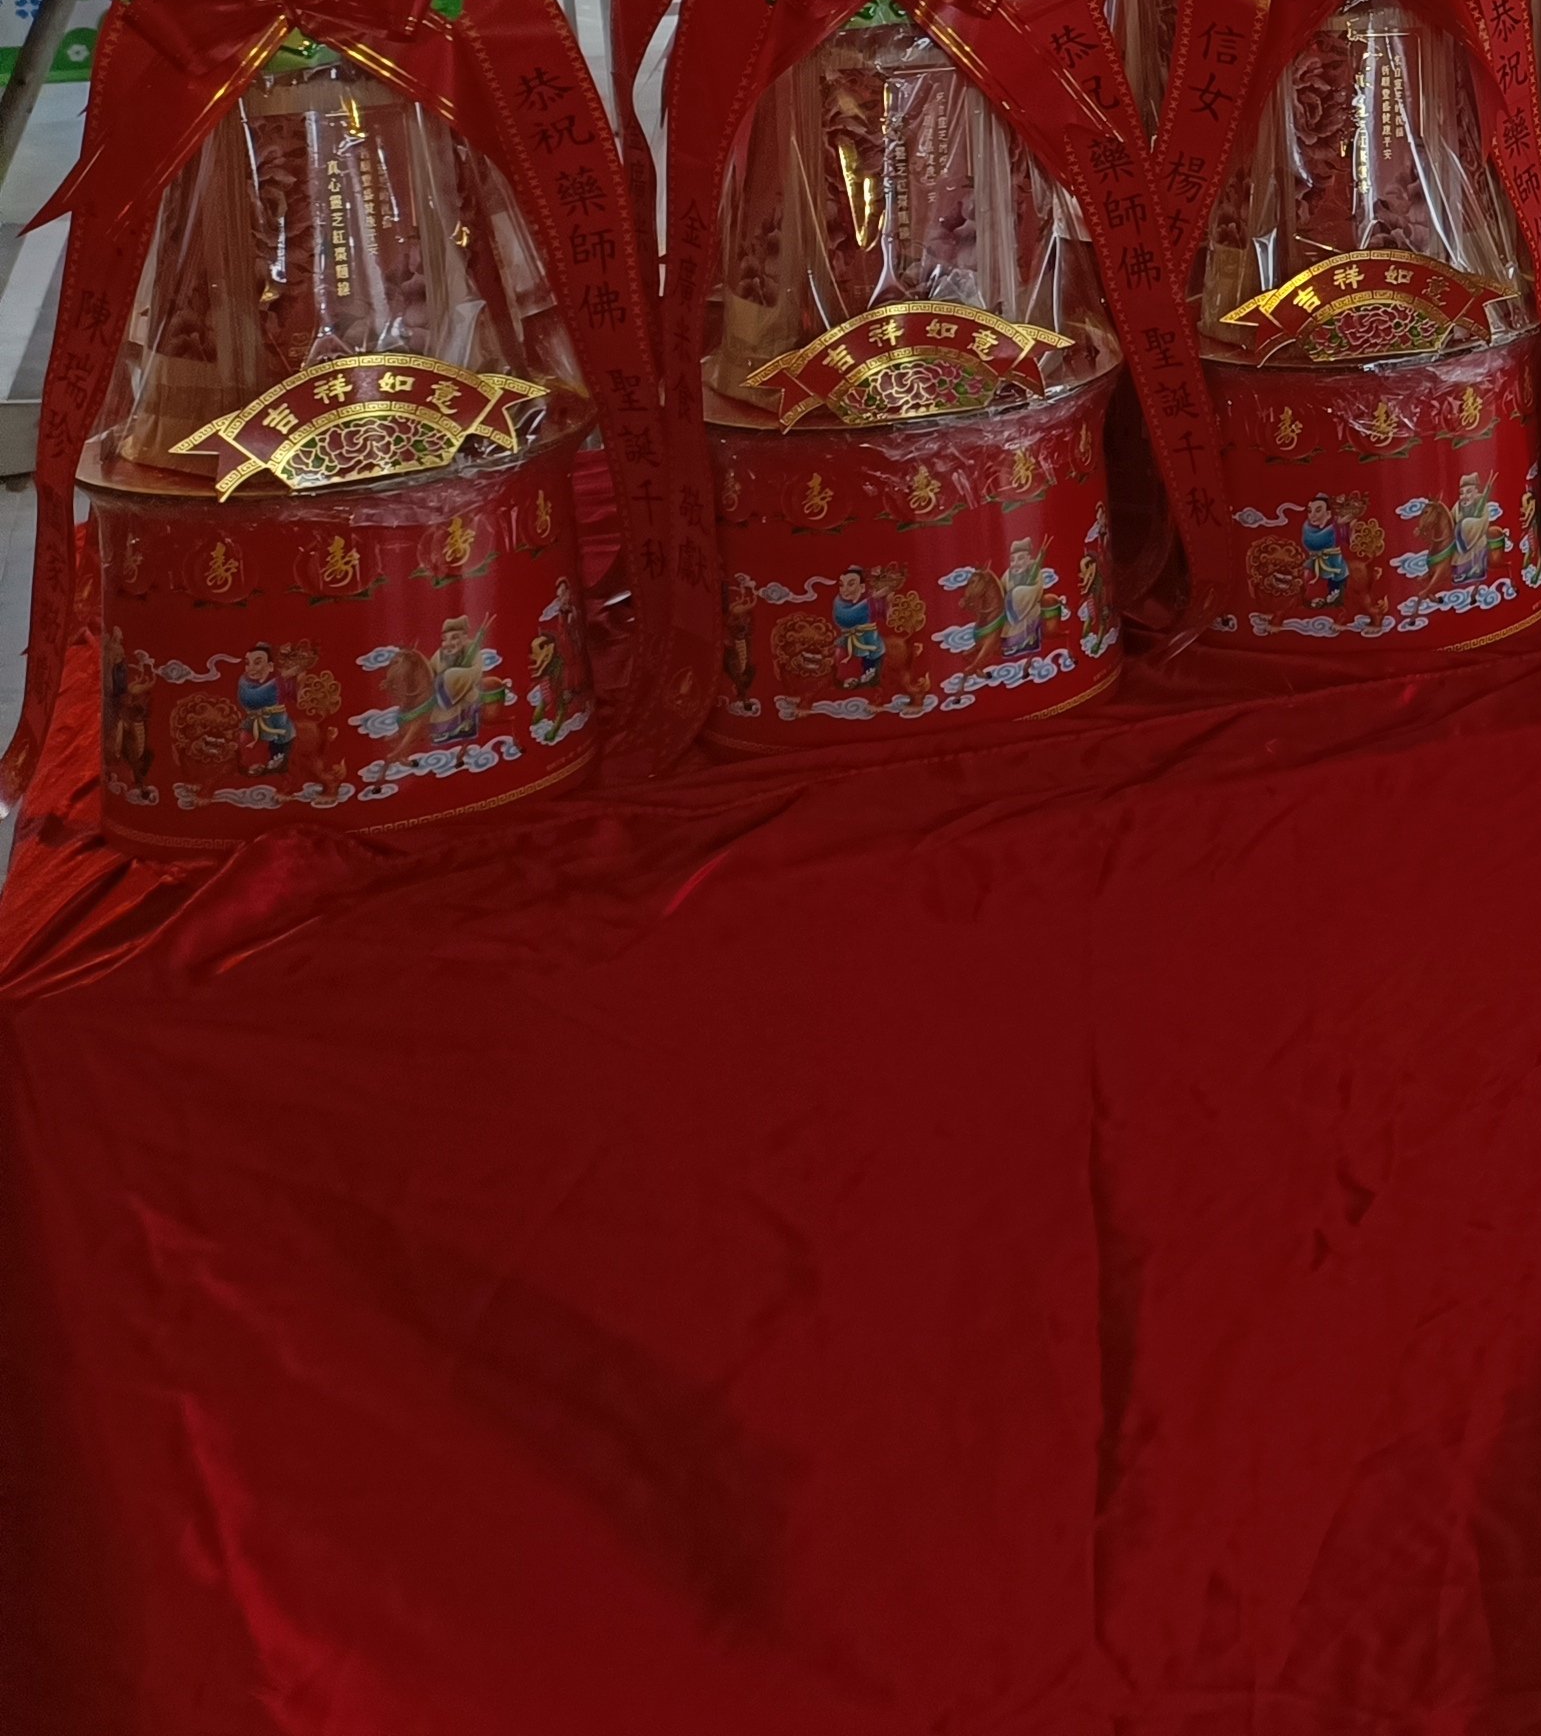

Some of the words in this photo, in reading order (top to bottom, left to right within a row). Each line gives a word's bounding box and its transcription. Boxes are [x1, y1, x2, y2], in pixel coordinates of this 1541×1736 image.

[1292, 267, 1449, 310] 吉祥如意
[822, 318, 1001, 372] 吉祥如意
[262, 370, 465, 435] 吉祥如意
